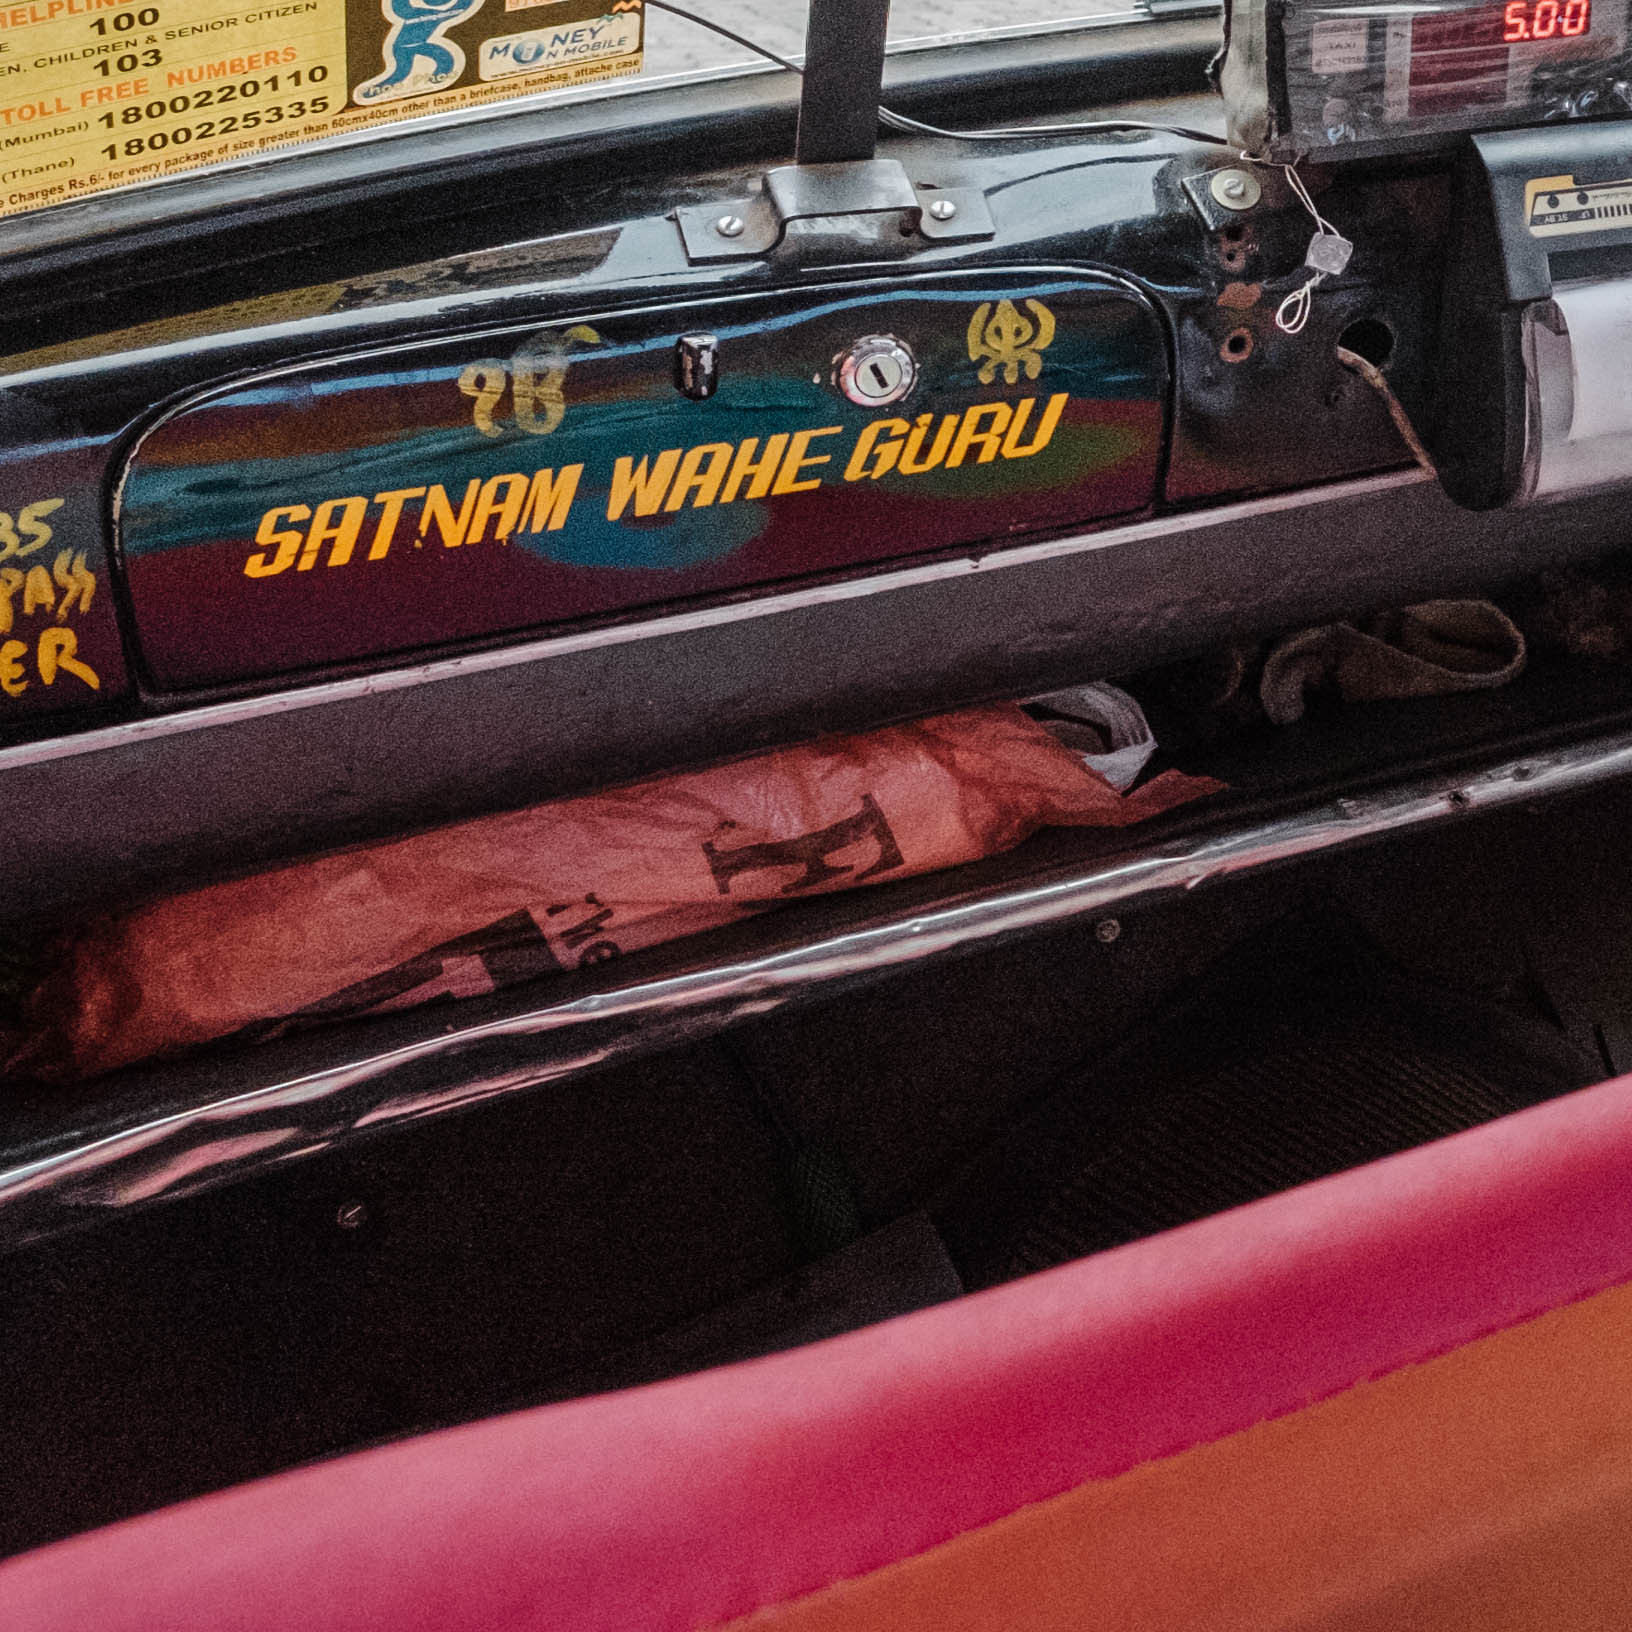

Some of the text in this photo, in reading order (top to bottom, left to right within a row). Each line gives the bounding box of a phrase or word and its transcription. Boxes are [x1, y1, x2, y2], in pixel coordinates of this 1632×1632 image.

[34, 39, 138, 68] CHILDREN
[145, 34, 158, 45] &
[164, 17, 239, 41] SENIOR
[245, 1, 318, 24] CITIZEN
[89, 7, 160, 36] 100
[563, 35, 629, 56] MOBILE
[0, 46, 298, 125] TOLL FREE NUMBERS
[93, 48, 163, 77] 103
[97, 65, 329, 130] 1800220110
[2, 96, 330, 185] (Thane) 1800225335
[8, 183, 65, 206] Charges
[108, 169, 126, 182] for
[128, 161, 161, 177] every
[164, 149, 214, 167] package
[217, 144, 229, 155] of
[233, 140, 255, 152] size
[258, 129, 301, 148] greater
[303, 121, 329, 135] than
[331, 107, 399, 128] 60cmx40cm
[401, 101, 430, 114] other
[433, 95, 457, 107] than
[459, 92, 466, 102] a
[469, 80, 522, 99] briefcase,
[574, 61, 613, 79] attache
[615, 58, 640, 70] case
[243, 392, 1070, 579] SATNAM WAHE GURU
